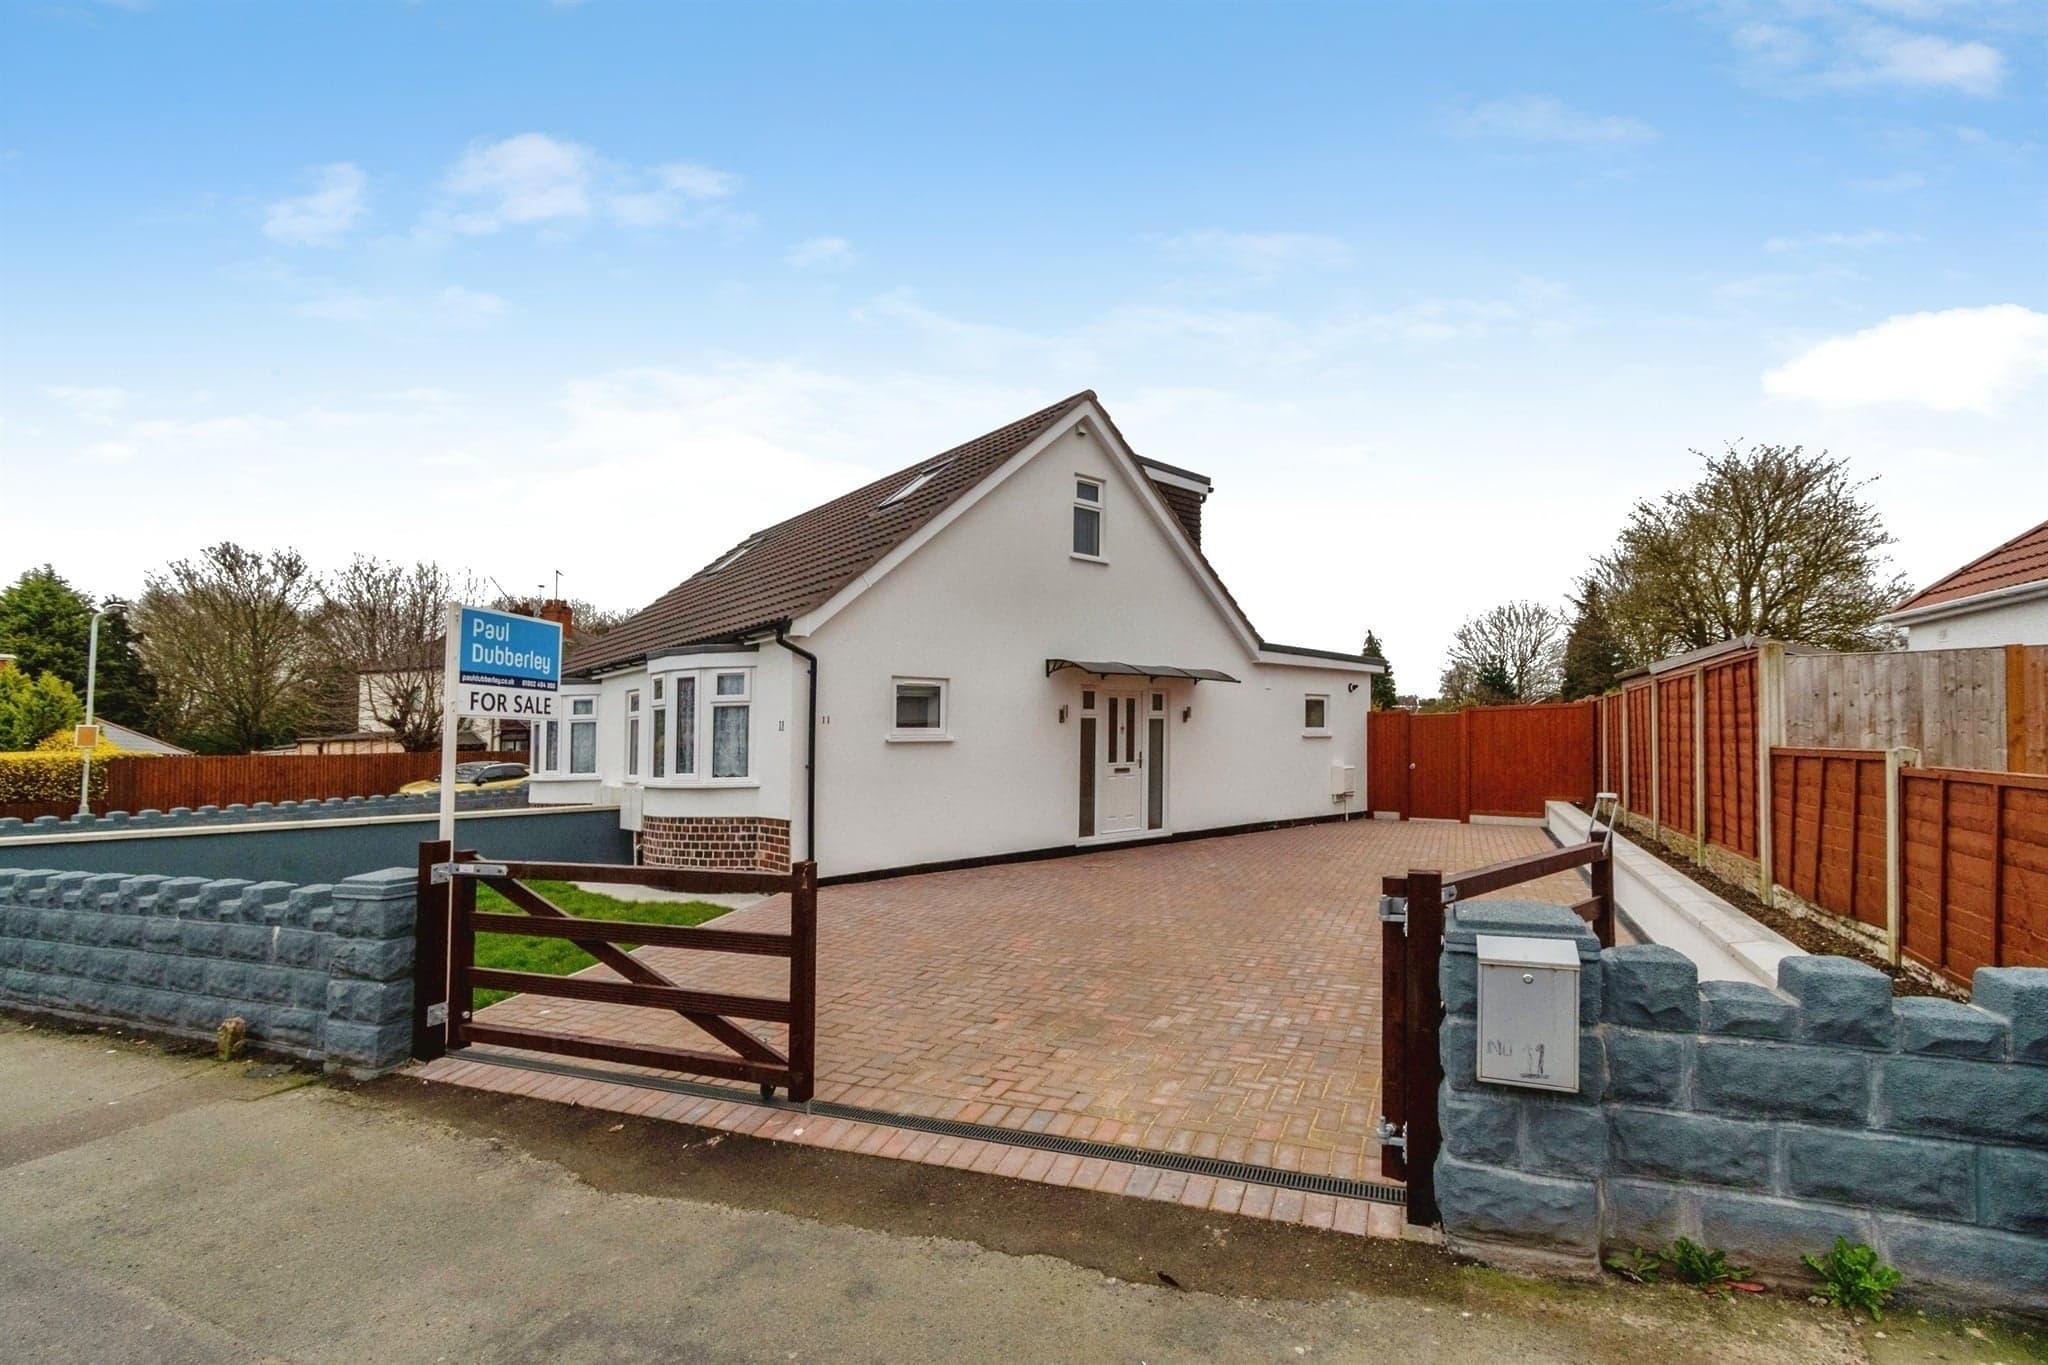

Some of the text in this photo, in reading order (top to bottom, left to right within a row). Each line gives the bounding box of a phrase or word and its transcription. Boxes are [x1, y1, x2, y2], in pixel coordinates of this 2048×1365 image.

[473, 619, 510, 642] Paul
[472, 643, 551, 674] Dubberley
[470, 692, 551, 715] FOR SALE
